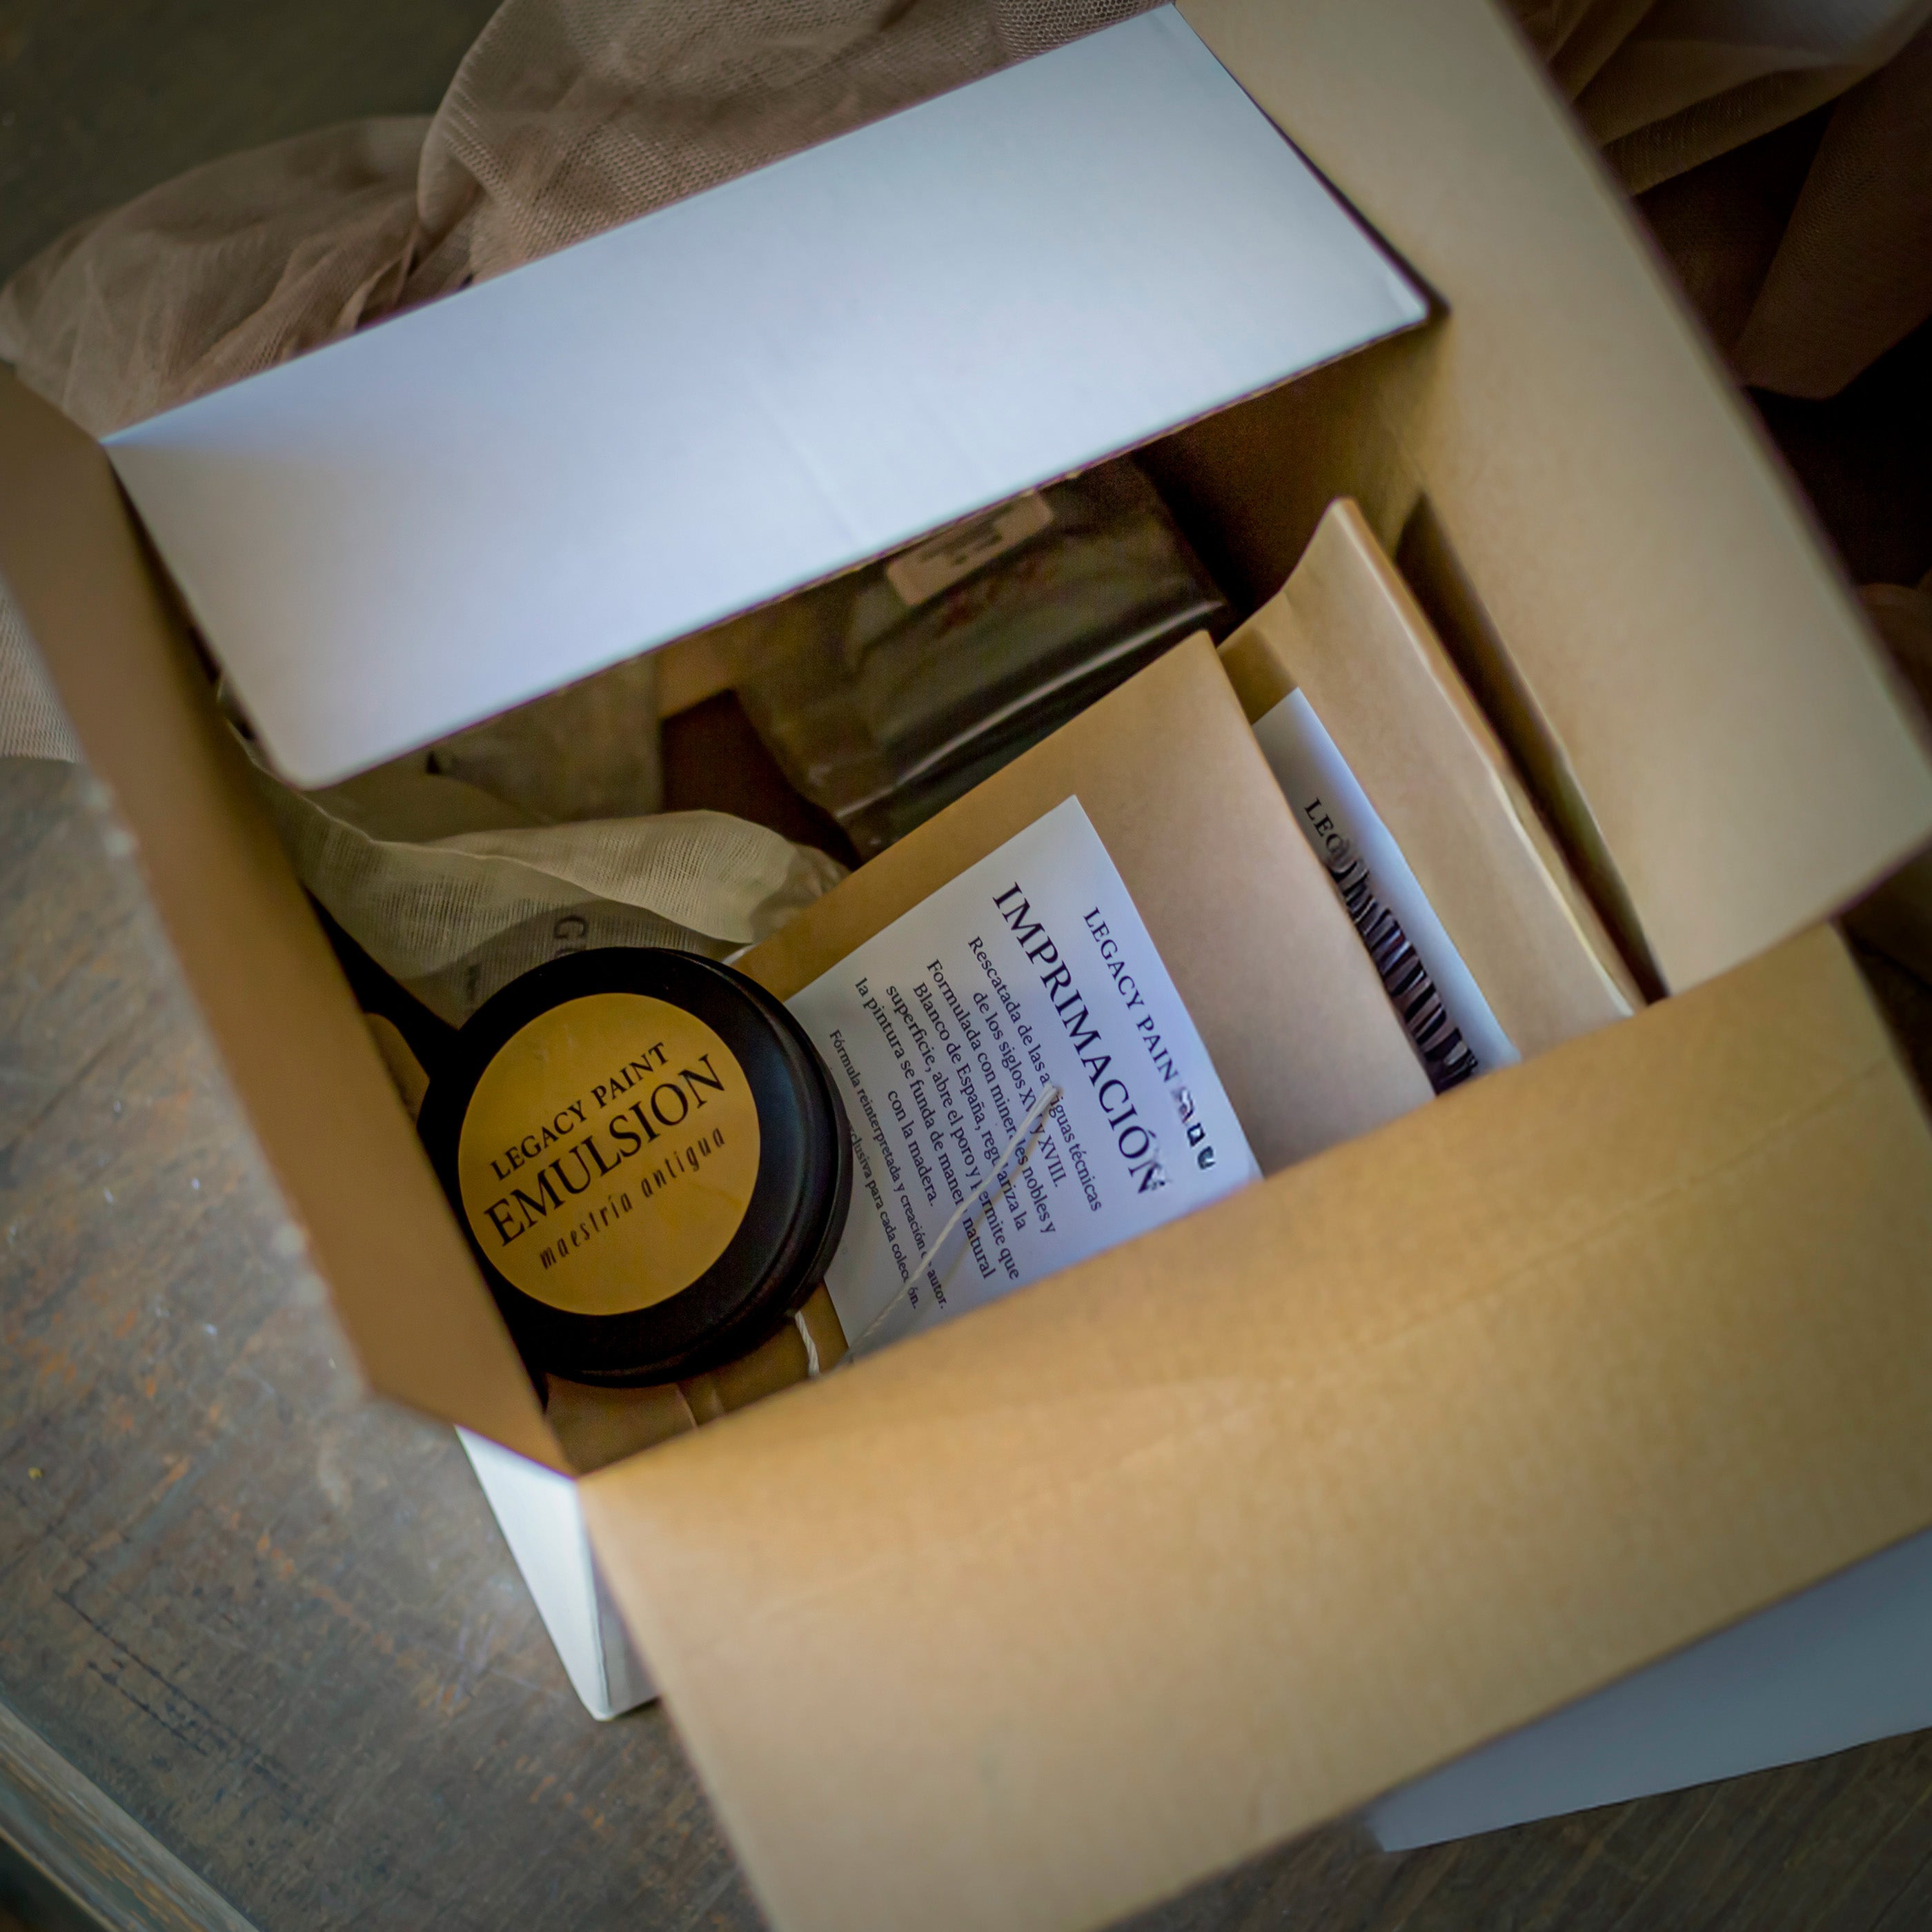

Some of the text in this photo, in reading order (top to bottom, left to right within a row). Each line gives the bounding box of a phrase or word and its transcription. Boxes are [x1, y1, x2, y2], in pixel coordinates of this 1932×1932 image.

[1083, 906, 1144, 1009] LEGACY
[885, 985, 935, 1072] superficie,
[926, 958, 981, 1052] Formulada
[976, 1052, 996, 1084] con
[1021, 1165, 1050, 1222] nobles
[1039, 1221, 1056, 1233] y
[931, 1071, 953, 1108] abre
[967, 935, 1102, 1211] Rescatada de las aiguas técnicas
[972, 992, 989, 1014] de
[984, 1011, 1003, 1041] los
[998, 1041, 1025, 1089] siglos
[1029, 1121, 1045, 1134] y
[1037, 1134, 1066, 1187] XVIII.
[992, 881, 1165, 1194] IMPRIMACIÓN
[484, 1055, 725, 1246] EMULSION
[491, 1042, 670, 1182] LEGACY PAINT
[829, 1028, 860, 1088] Fórmula
[856, 1087, 901, 1183] reinterpretada
[893, 1182, 905, 1192] y
[900, 1194, 925, 1251] creación
[926, 1269, 947, 1309] autor.
[854, 976, 996, 1279] la pintura se funda de maner natural
[887, 1090, 936, 1207] con la madera.
[912, 981, 950, 1041] Blanco
[945, 1042, 961, 1064] de
[956, 1062, 985, 1131] España,
[1013, 1210, 1027, 1231] la
[947, 1110, 964, 1127] el
[949, 1125, 975, 1165] poro
[965, 1165, 980, 1177] y
[539, 1127, 725, 1270] maestría antigua
[864, 1179, 884, 1210] para
[879, 1210, 896, 1243] cada
[997, 1247, 1019, 1279] que
